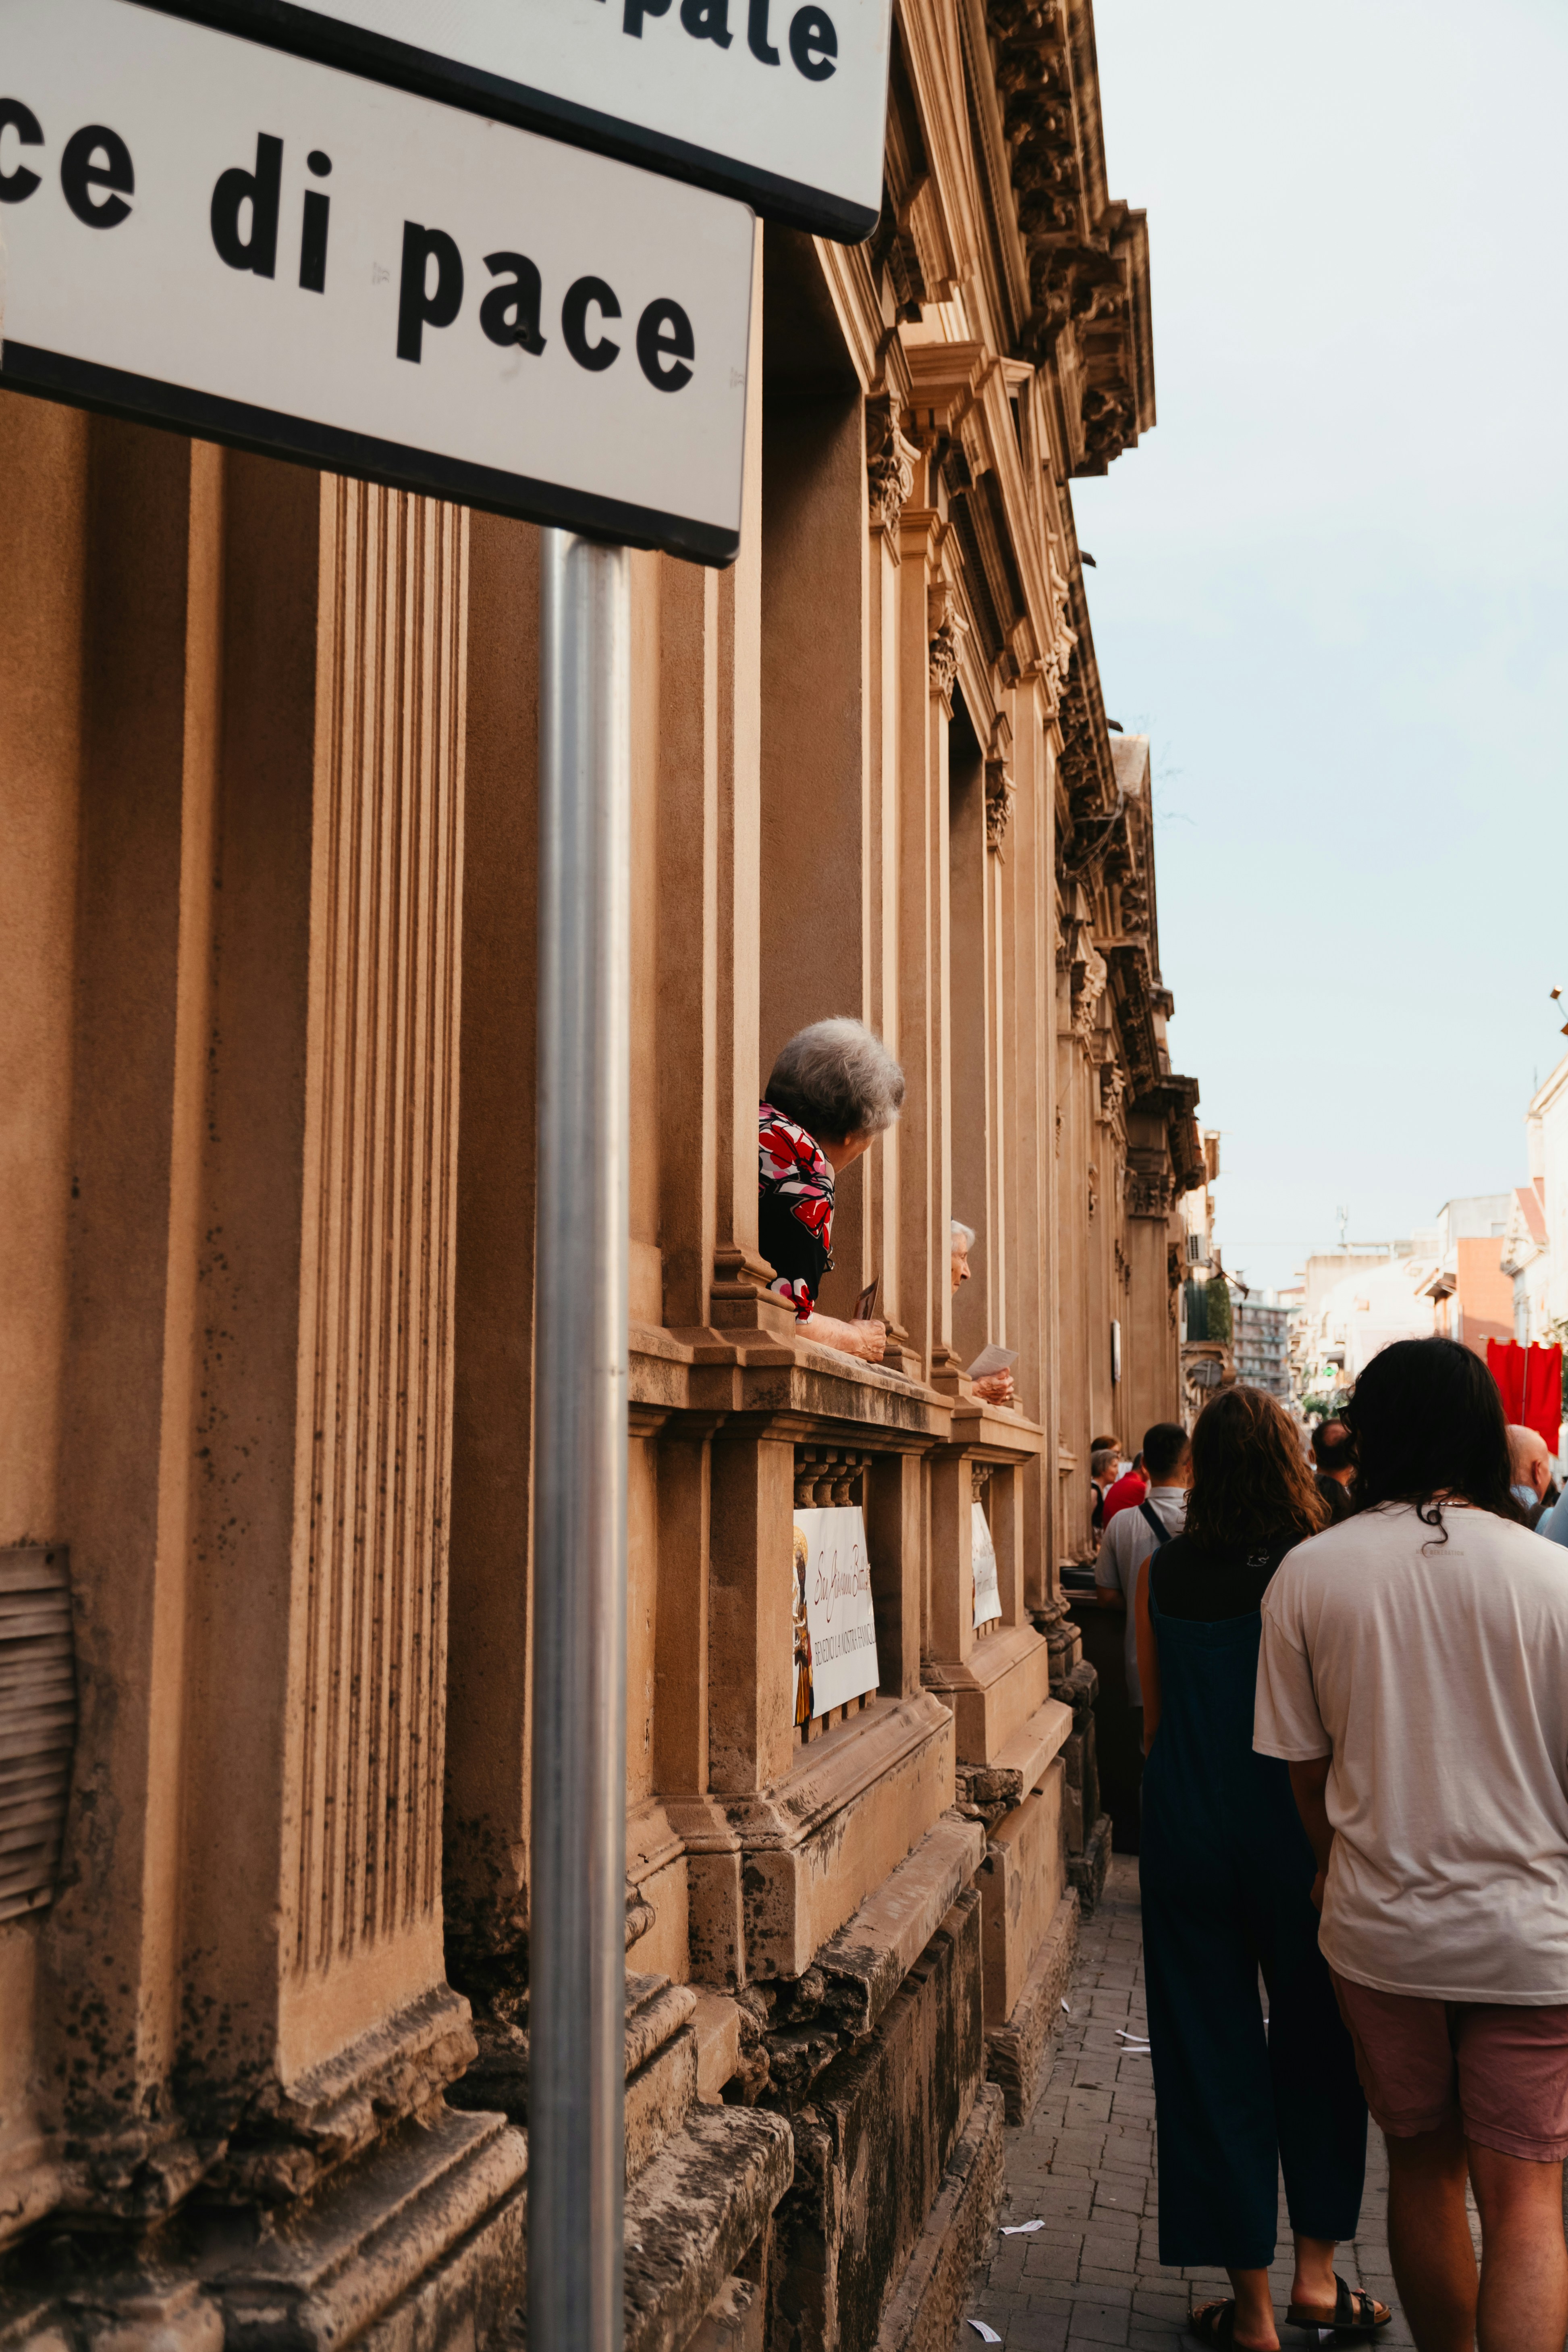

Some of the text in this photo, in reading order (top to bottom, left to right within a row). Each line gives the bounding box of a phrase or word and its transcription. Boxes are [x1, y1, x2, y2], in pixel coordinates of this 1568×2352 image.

[210, 132, 332, 295] di
[397, 220, 695, 393] pace
[814, 1550, 829, 1606] San
[835, 1634, 841, 1658] LA
[841, 1628, 858, 1656] NOSTRA
